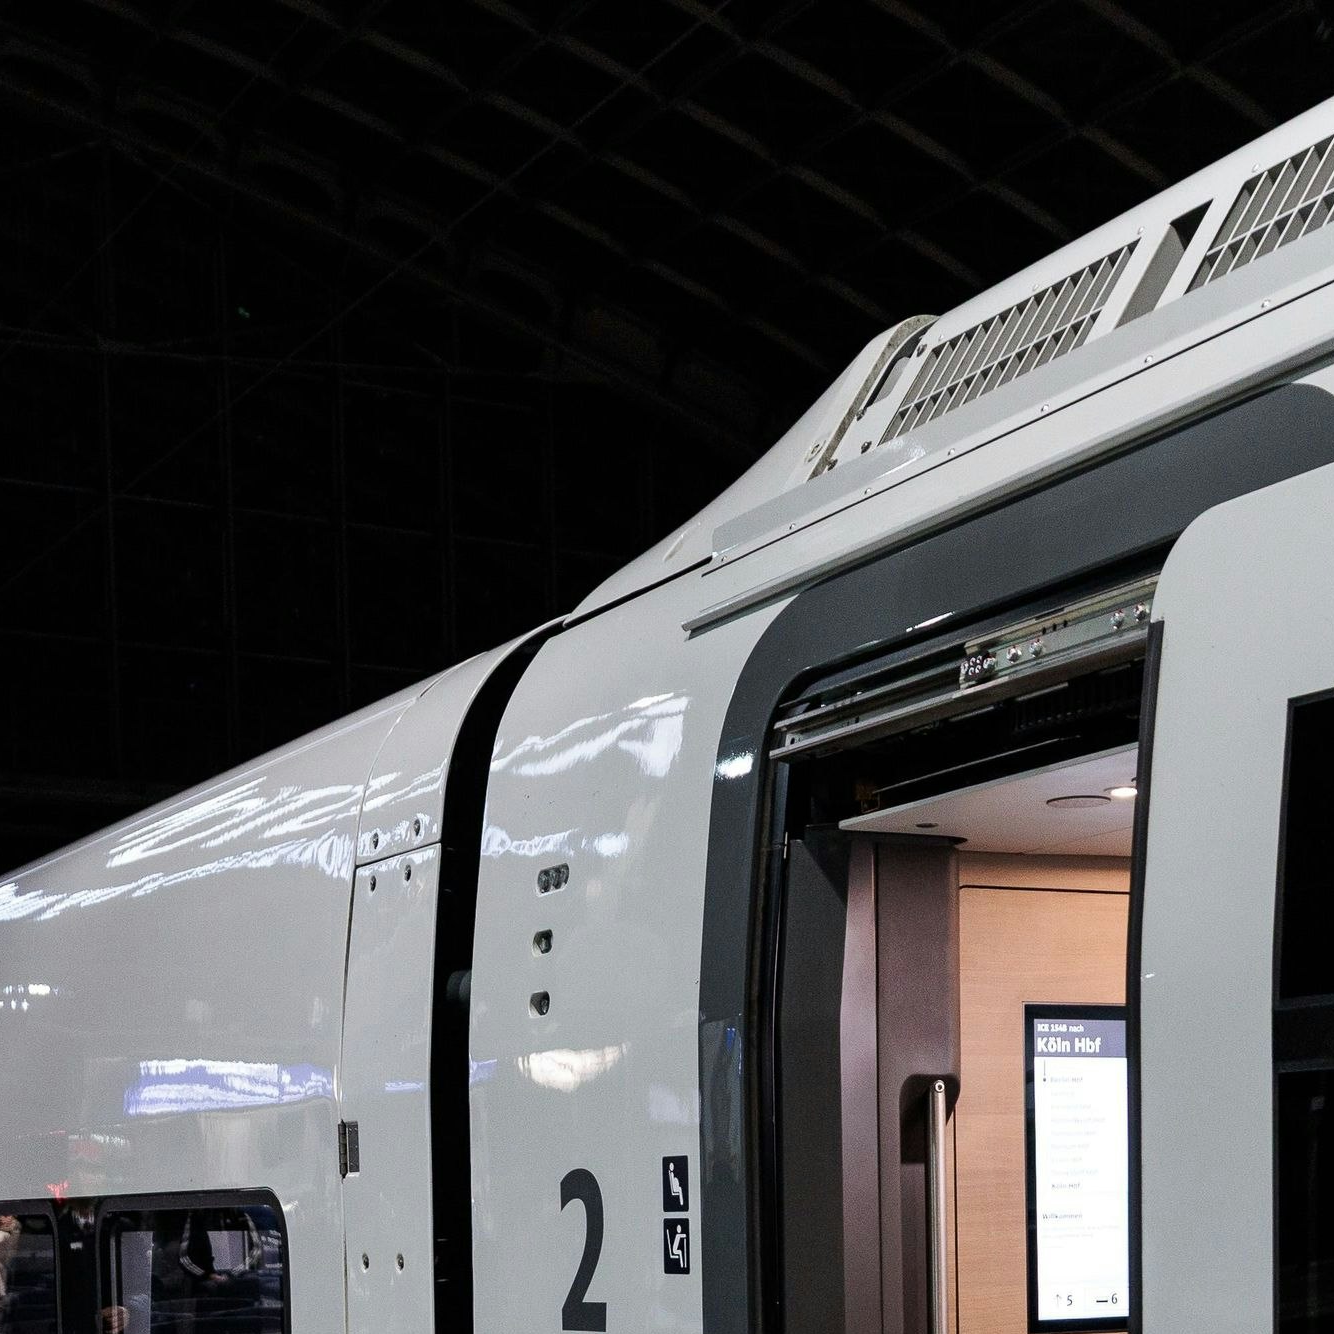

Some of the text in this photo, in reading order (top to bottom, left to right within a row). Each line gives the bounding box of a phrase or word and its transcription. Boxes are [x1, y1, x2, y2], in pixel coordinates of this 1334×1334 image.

[1037, 1023, 1084, 1032] ICE 1548 nach
[1037, 1037, 1101, 1053] Köln Hbf
[560, 1169, 606, 1332] 2
[1066, 1294, 1073, 1307] 5
[1111, 1292, 1118, 1304] 6
